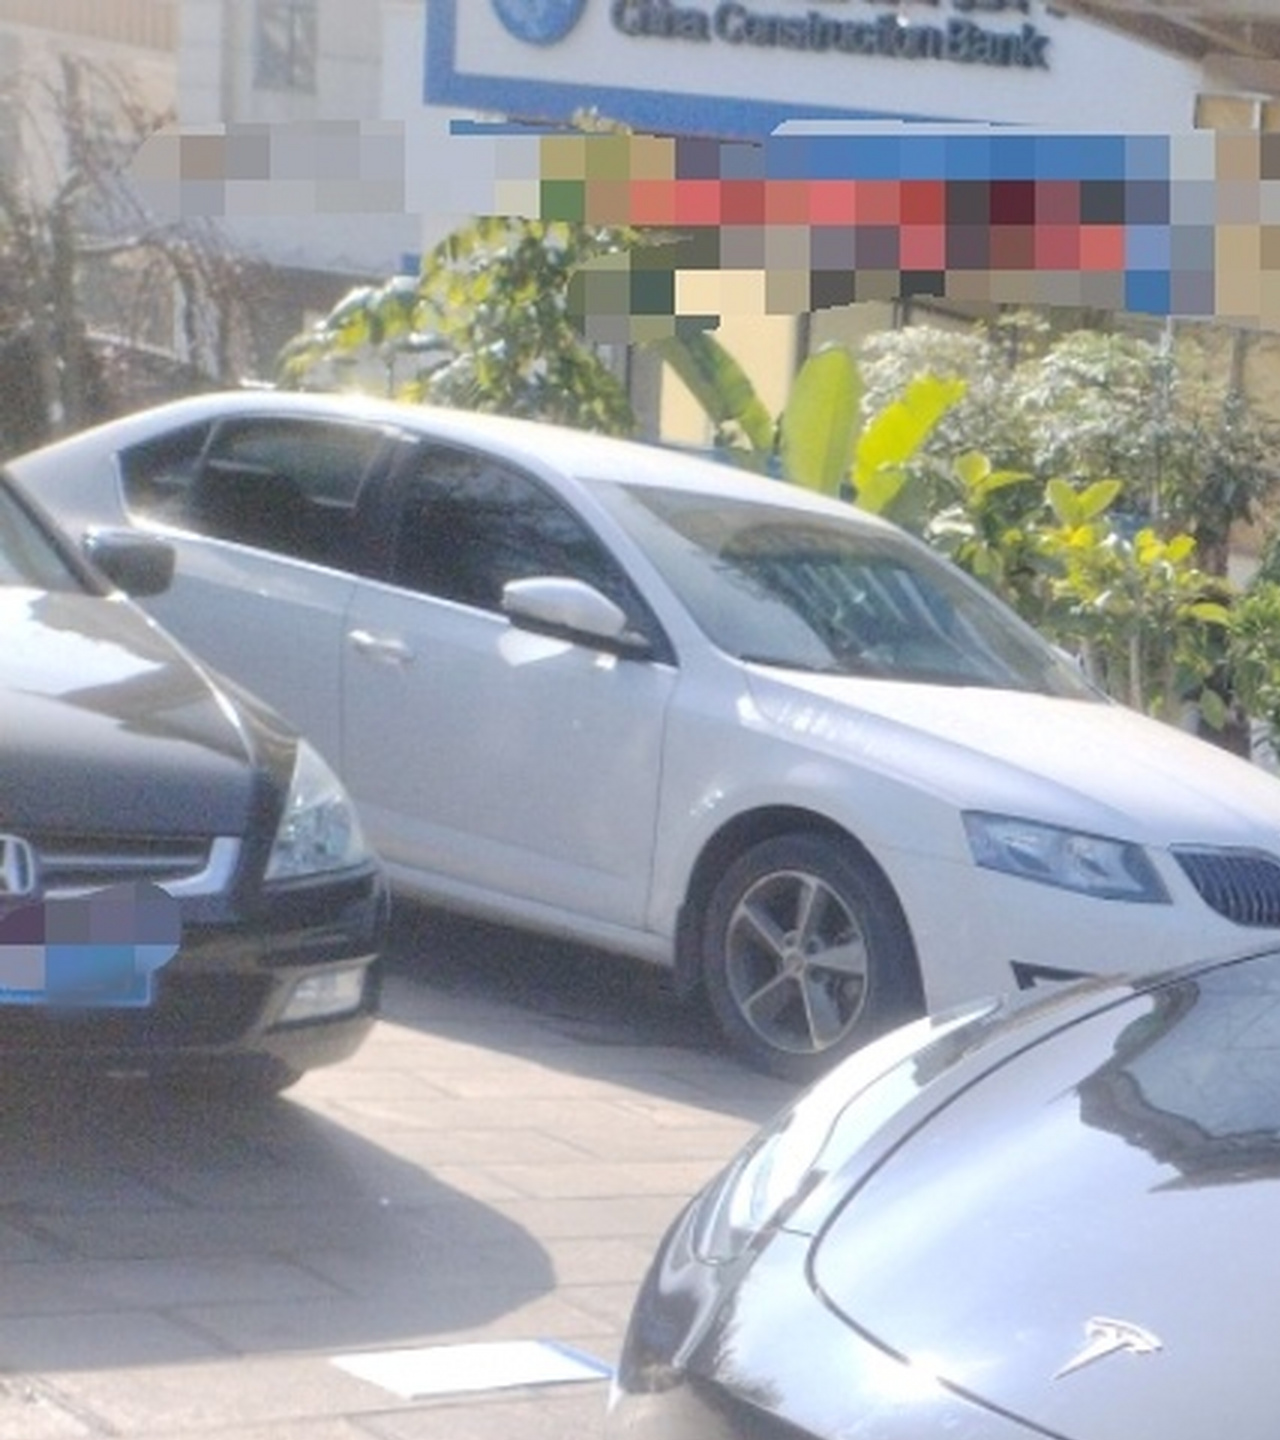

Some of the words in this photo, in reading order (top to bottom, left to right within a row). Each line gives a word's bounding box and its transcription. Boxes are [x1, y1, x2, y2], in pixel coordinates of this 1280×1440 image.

[610, 0, 711, 44] China
[714, 2, 944, 60] Construction
[946, 17, 1050, 70] Bank
